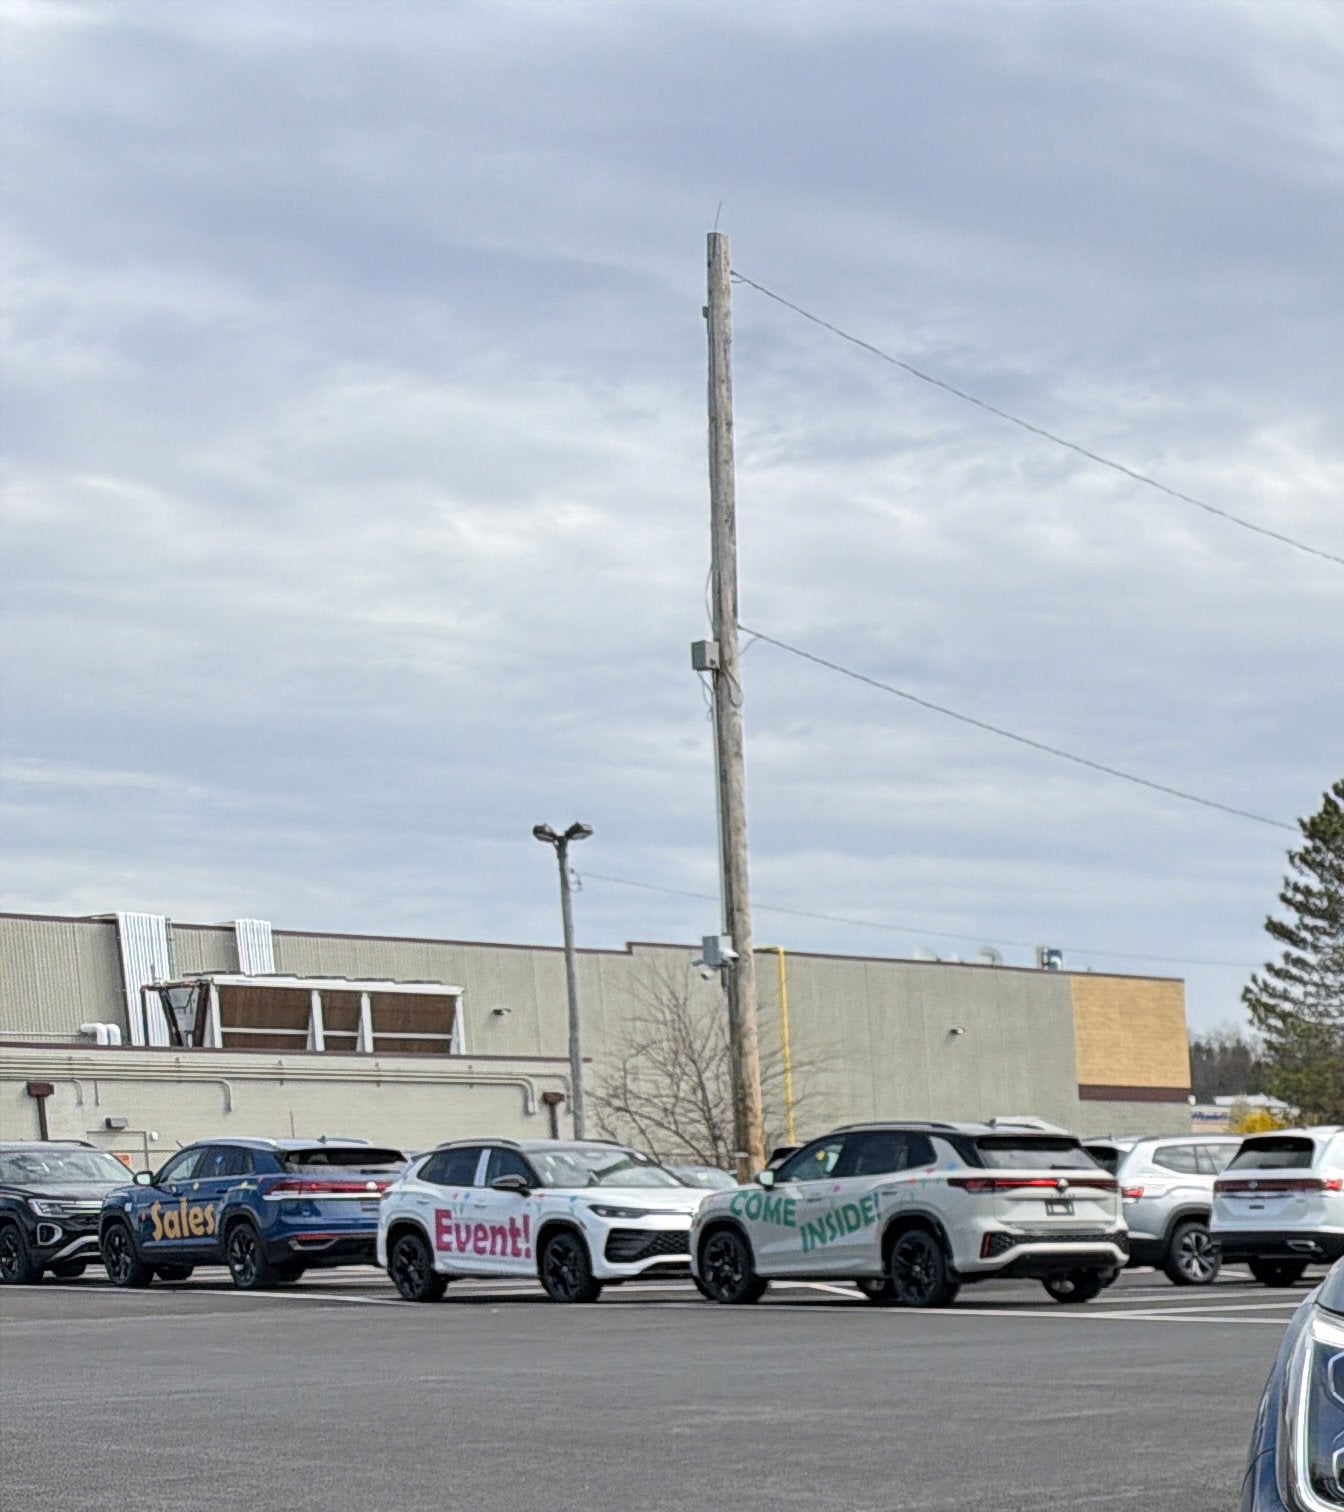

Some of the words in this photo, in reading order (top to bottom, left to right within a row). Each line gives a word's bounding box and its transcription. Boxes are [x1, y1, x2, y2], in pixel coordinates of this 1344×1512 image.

[151, 1197, 215, 1241] Sales
[435, 1208, 531, 1259] Event!
[730, 1190, 796, 1228] COME
[800, 1192, 882, 1254] INSIDE!
